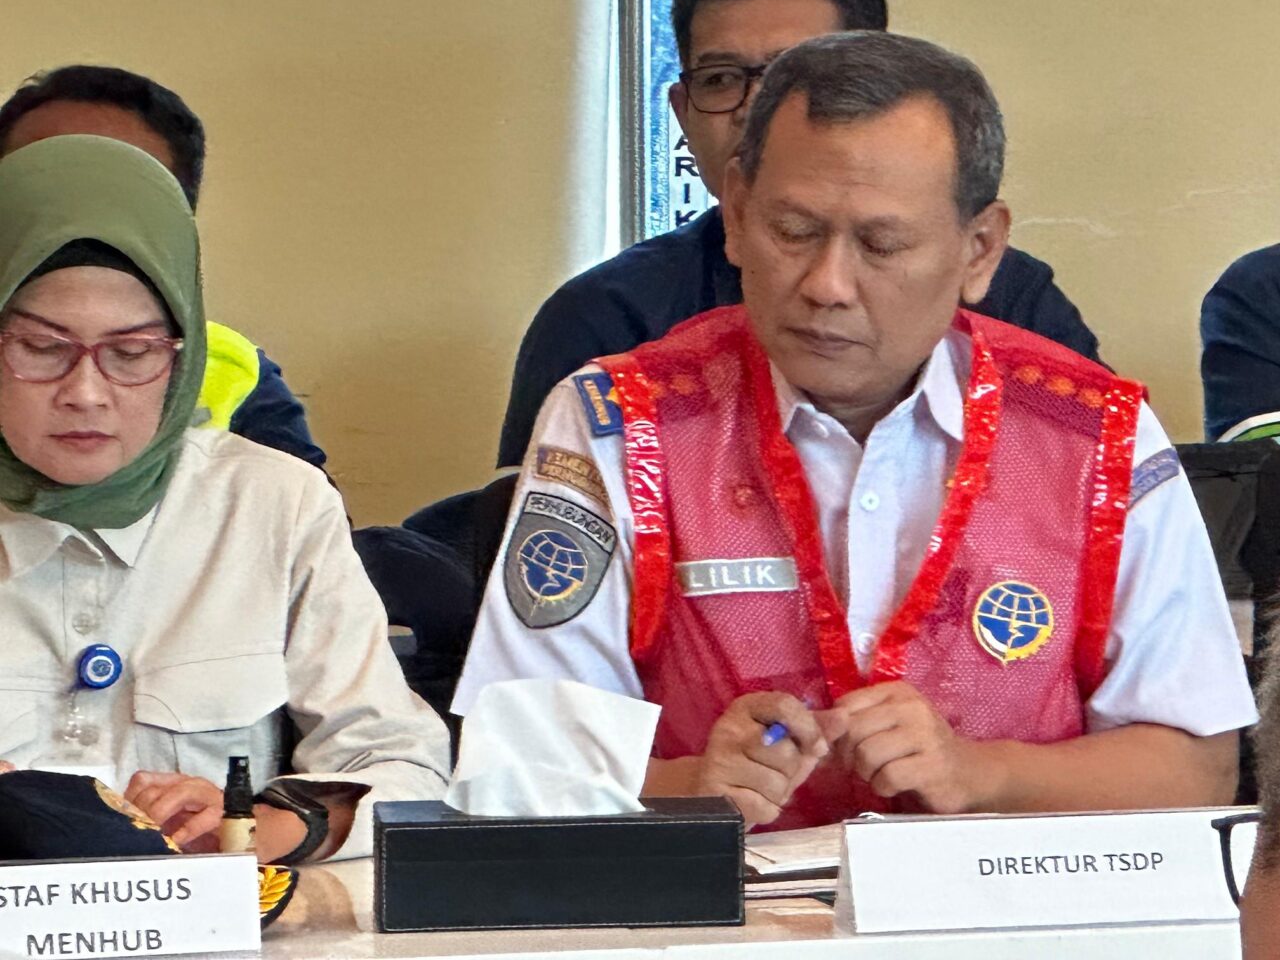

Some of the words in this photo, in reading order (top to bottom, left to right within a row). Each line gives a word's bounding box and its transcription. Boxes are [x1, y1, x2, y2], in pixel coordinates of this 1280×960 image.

[688, 565, 776, 588] LILIK
[978, 854, 1098, 876] DIREKTUR
[1103, 852, 1163, 872] TSDP
[71, 877, 192, 905] KHUSUS
[27, 929, 163, 955] MENHUB
